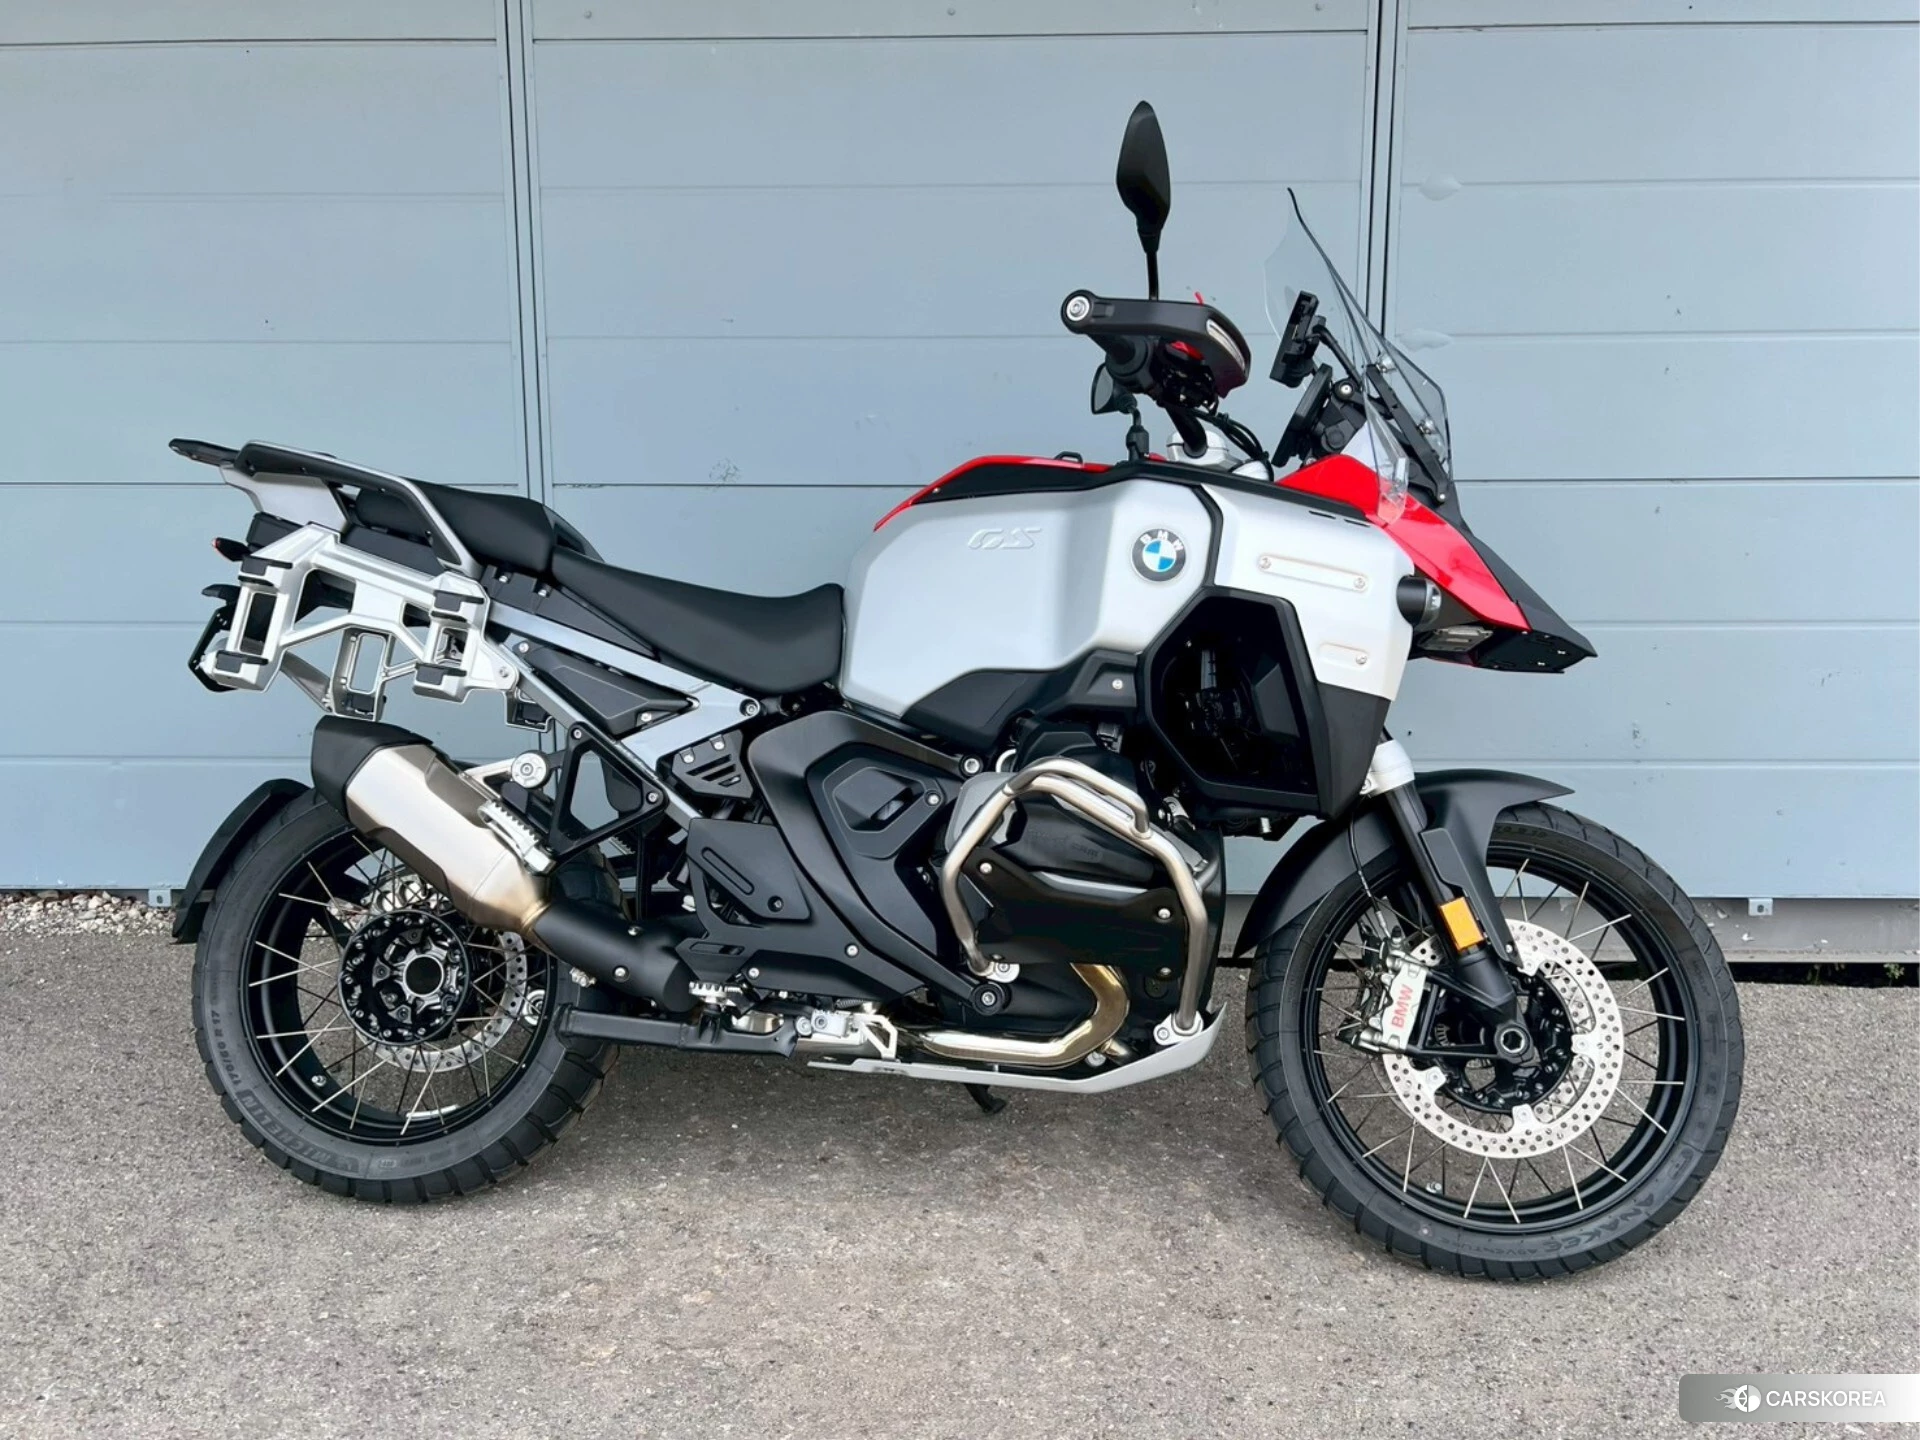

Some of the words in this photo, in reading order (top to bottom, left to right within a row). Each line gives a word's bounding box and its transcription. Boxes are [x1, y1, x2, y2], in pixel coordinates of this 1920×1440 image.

[967, 528, 1043, 551] GS
[1139, 529, 1184, 551] BMW
[1391, 983, 1414, 1028] BMW
[242, 1095, 332, 1162] MICHELIN
[1543, 1193, 1654, 1251] ANAKEE
